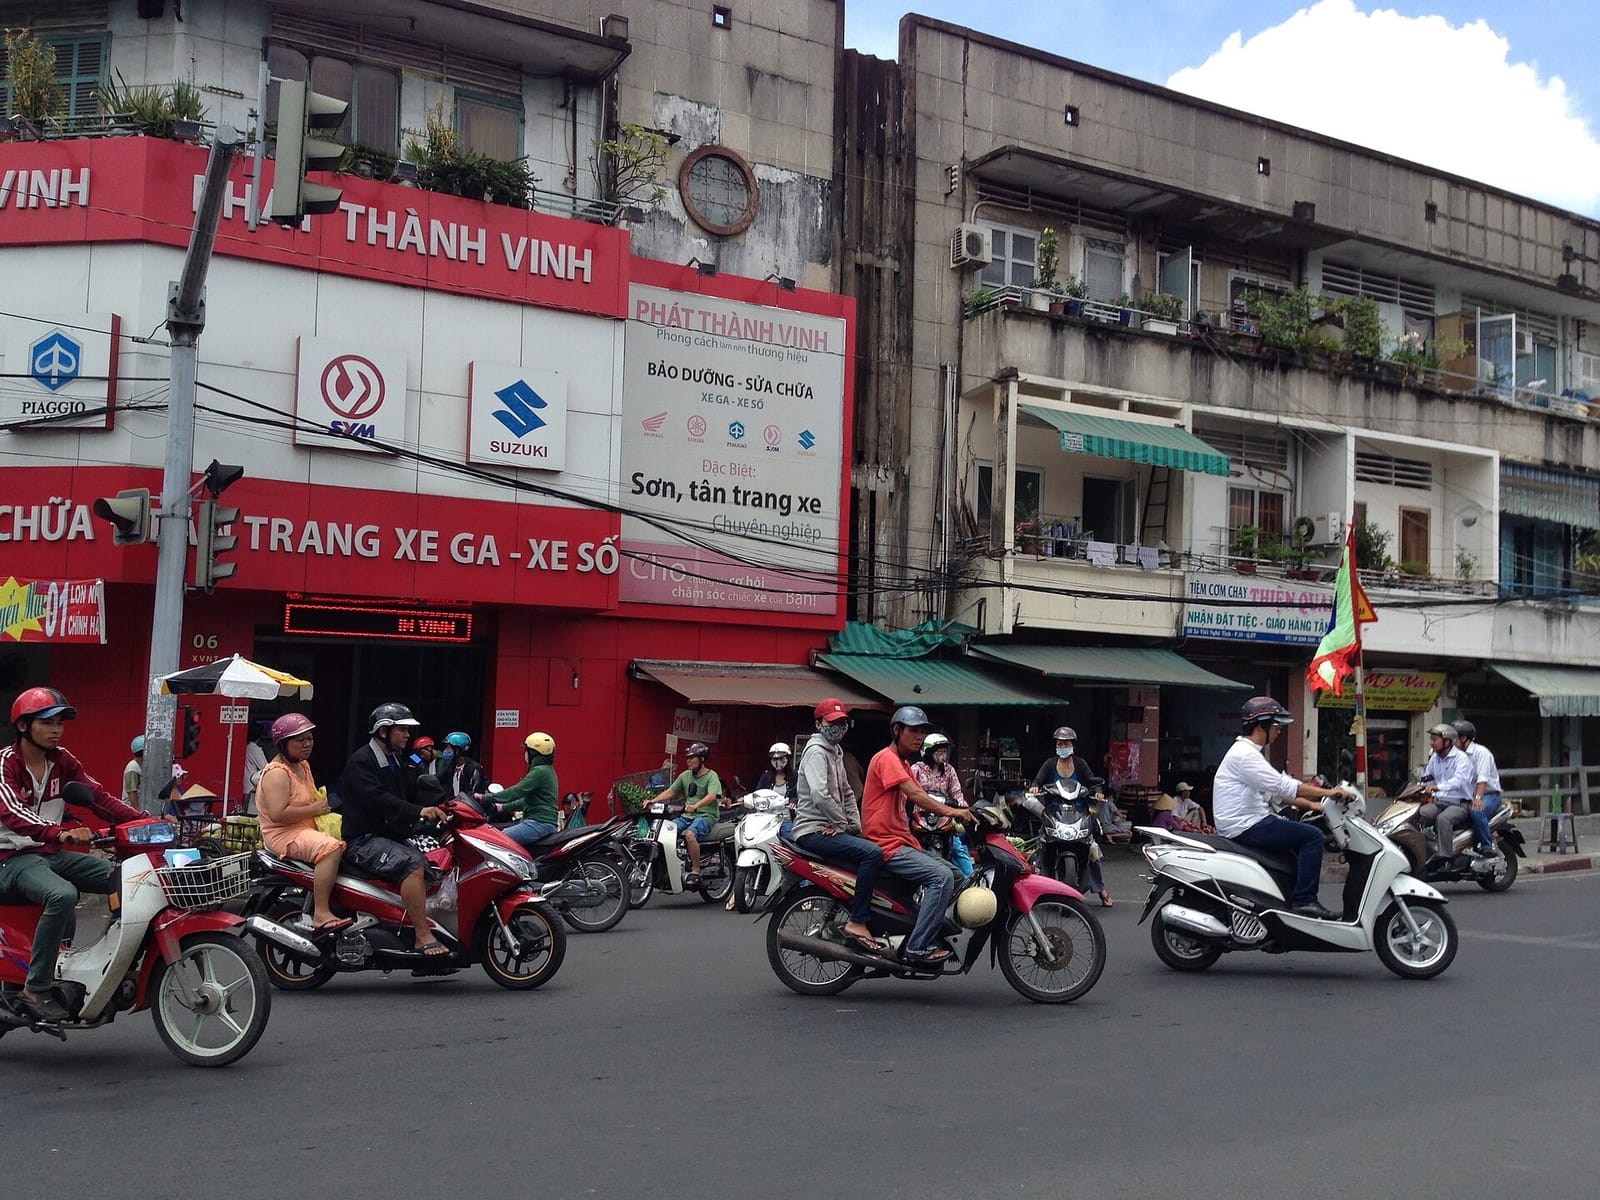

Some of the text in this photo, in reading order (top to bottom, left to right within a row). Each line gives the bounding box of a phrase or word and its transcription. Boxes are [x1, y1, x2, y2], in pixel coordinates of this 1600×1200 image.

[339, 201, 487, 266] THÀNH
[501, 233, 593, 284] VINH
[636, 300, 829, 352] PHÁT THÀNH VINH
[656, 328, 692, 348] Phong
[694, 333, 718, 349] cách
[747, 344, 784, 363] thương
[787, 350, 808, 364] hiệu
[647, 359, 678, 379] BẢO
[682, 368, 735, 389] DƯỠNG
[746, 374, 773, 394] SỬA
[777, 382, 814, 400] CHỮA
[21, 401, 86, 415] PIAGGIO
[701, 392, 714, 403] XE
[715, 393, 730, 405] GA
[737, 396, 749, 408] XE
[329, 420, 375, 439] SYM
[490, 440, 549, 458] SUZUKI
[702, 459, 756, 481] Đặc Biệt:
[631, 472, 821, 516] Sơn, tân trang xe
[712, 515, 822, 544] Chuyên nghiệp
[243, 516, 380, 559] TRANG
[394, 527, 439, 563] XE
[450, 532, 500, 566] GA
[527, 539, 569, 572] XE
[576, 534, 620, 575] SỐ
[630, 553, 687, 583] Cho
[672, 585, 704, 600] chăm
[706, 587, 725, 601] sóc
[754, 592, 767, 603] xe
[1190, 580, 1207, 598] TIỆM
[1208, 583, 1226, 597] CƠM
[1228, 585, 1248, 599] CHAY
[46, 581, 69, 637] 01
[1187, 609, 1213, 627] NHẬN
[1216, 611, 1233, 629] ĐẶT
[1237, 612, 1258, 634] TIỆC
[1266, 618, 1286, 630] GIAO
[1288, 617, 1312, 633] HÀNG
[193, 634, 219, 650] 06
[674, 714, 695, 734] CƠM
